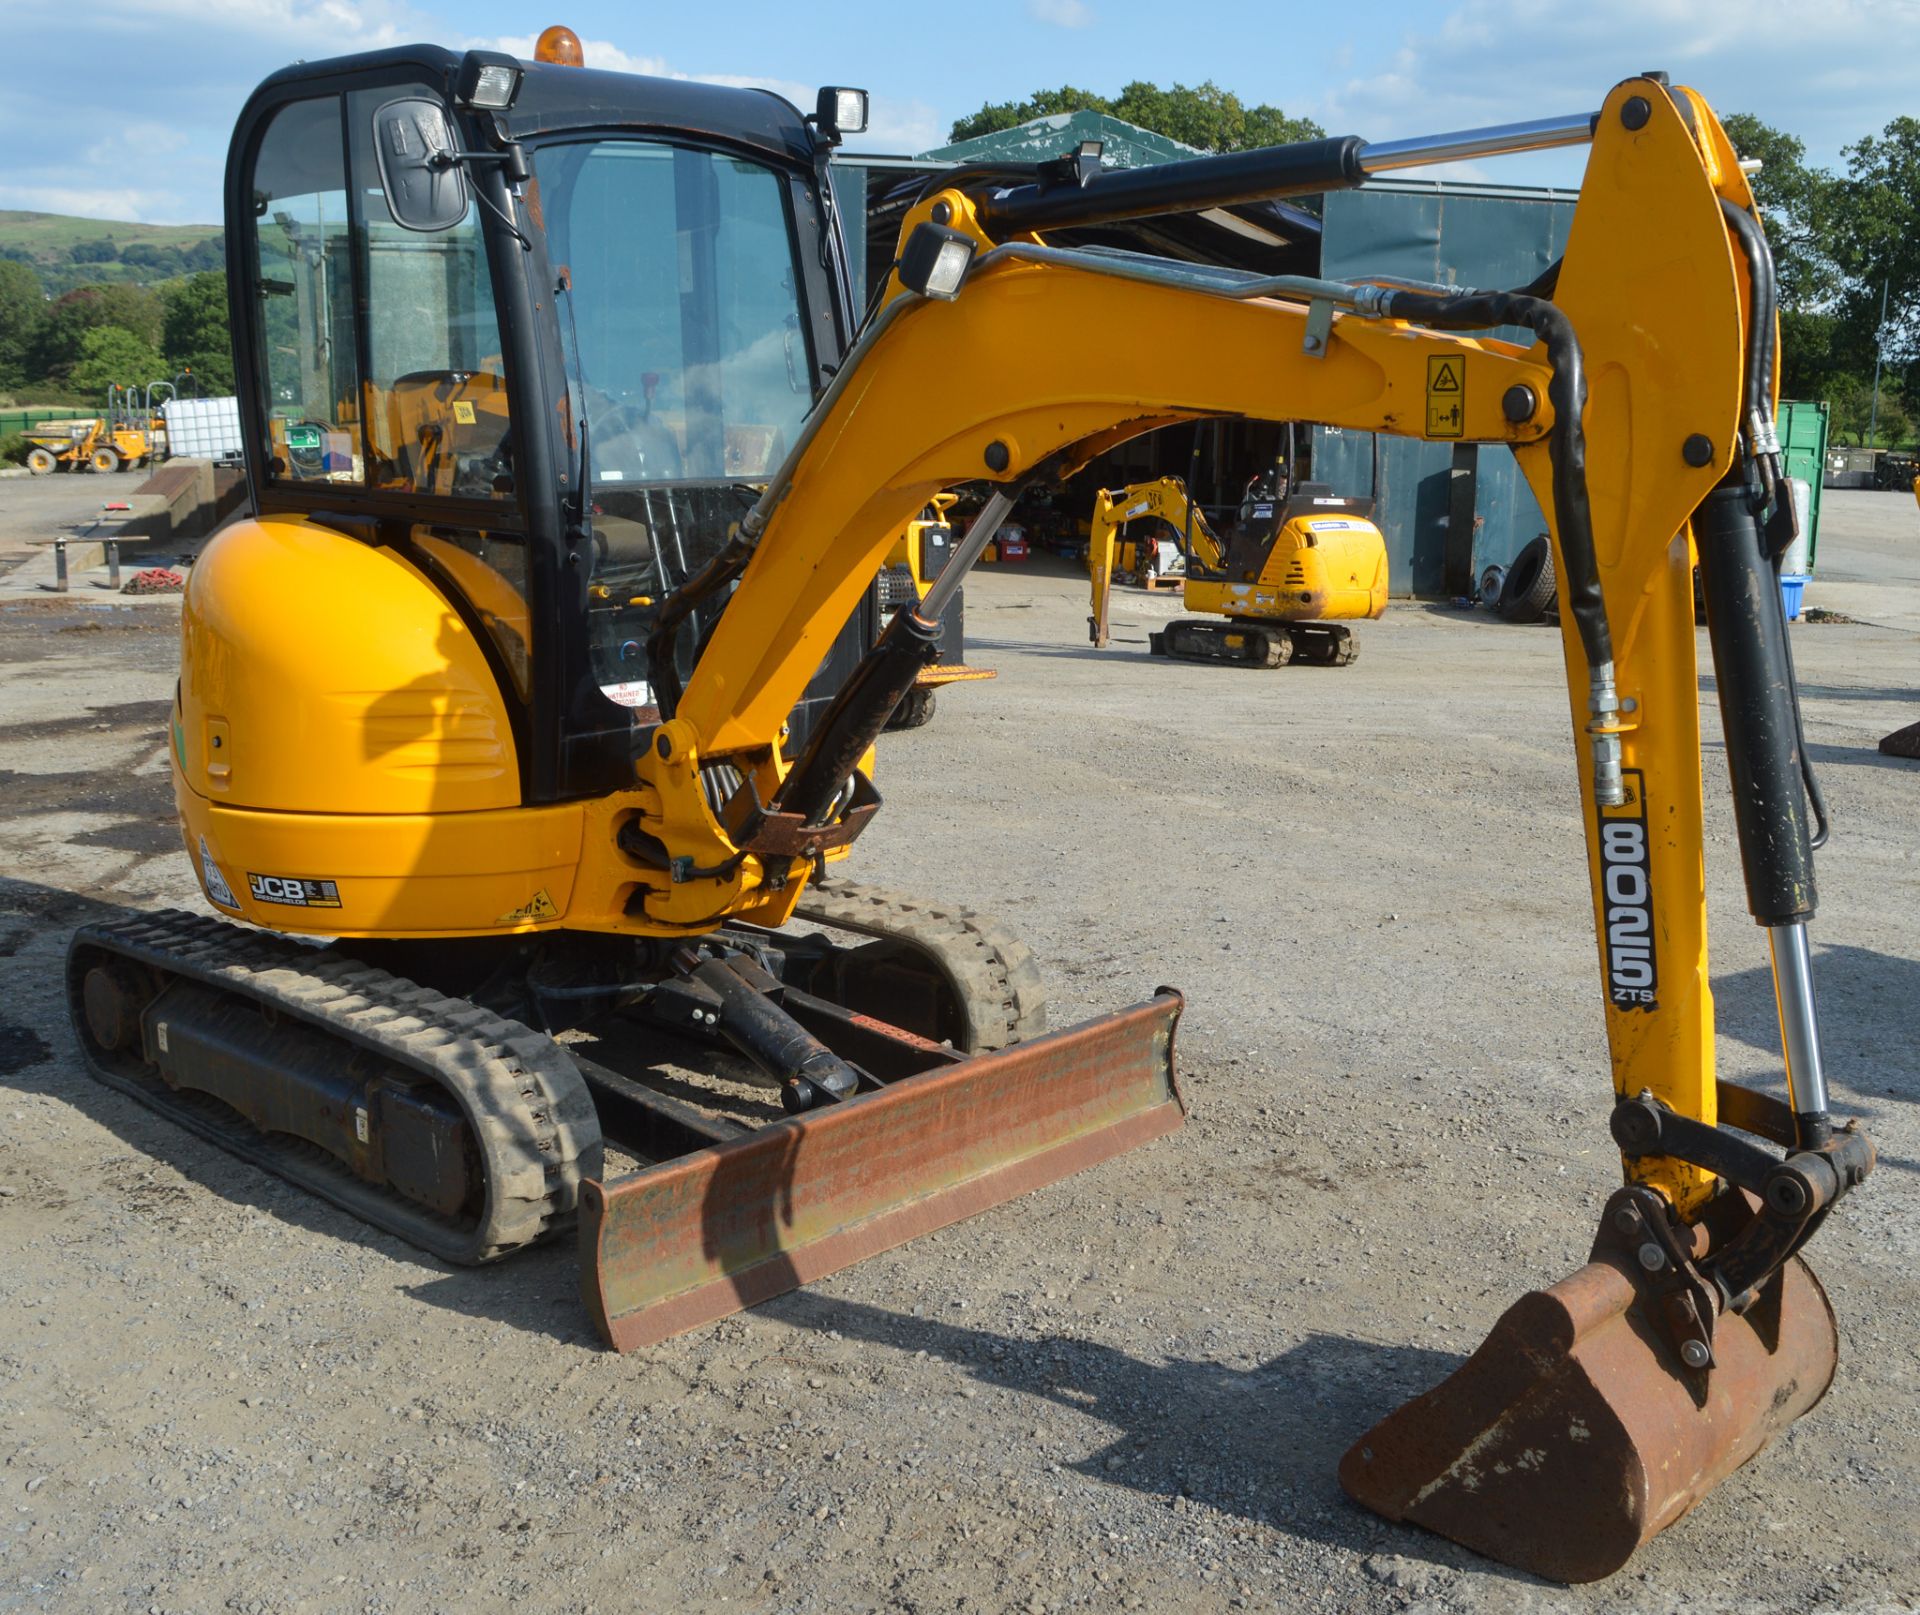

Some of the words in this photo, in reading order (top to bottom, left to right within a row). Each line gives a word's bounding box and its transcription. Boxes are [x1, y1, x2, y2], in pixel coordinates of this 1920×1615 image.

[252, 875, 305, 899] JCB
[1603, 823, 1653, 987] 8025
[1614, 988, 1655, 1003] ZTS
